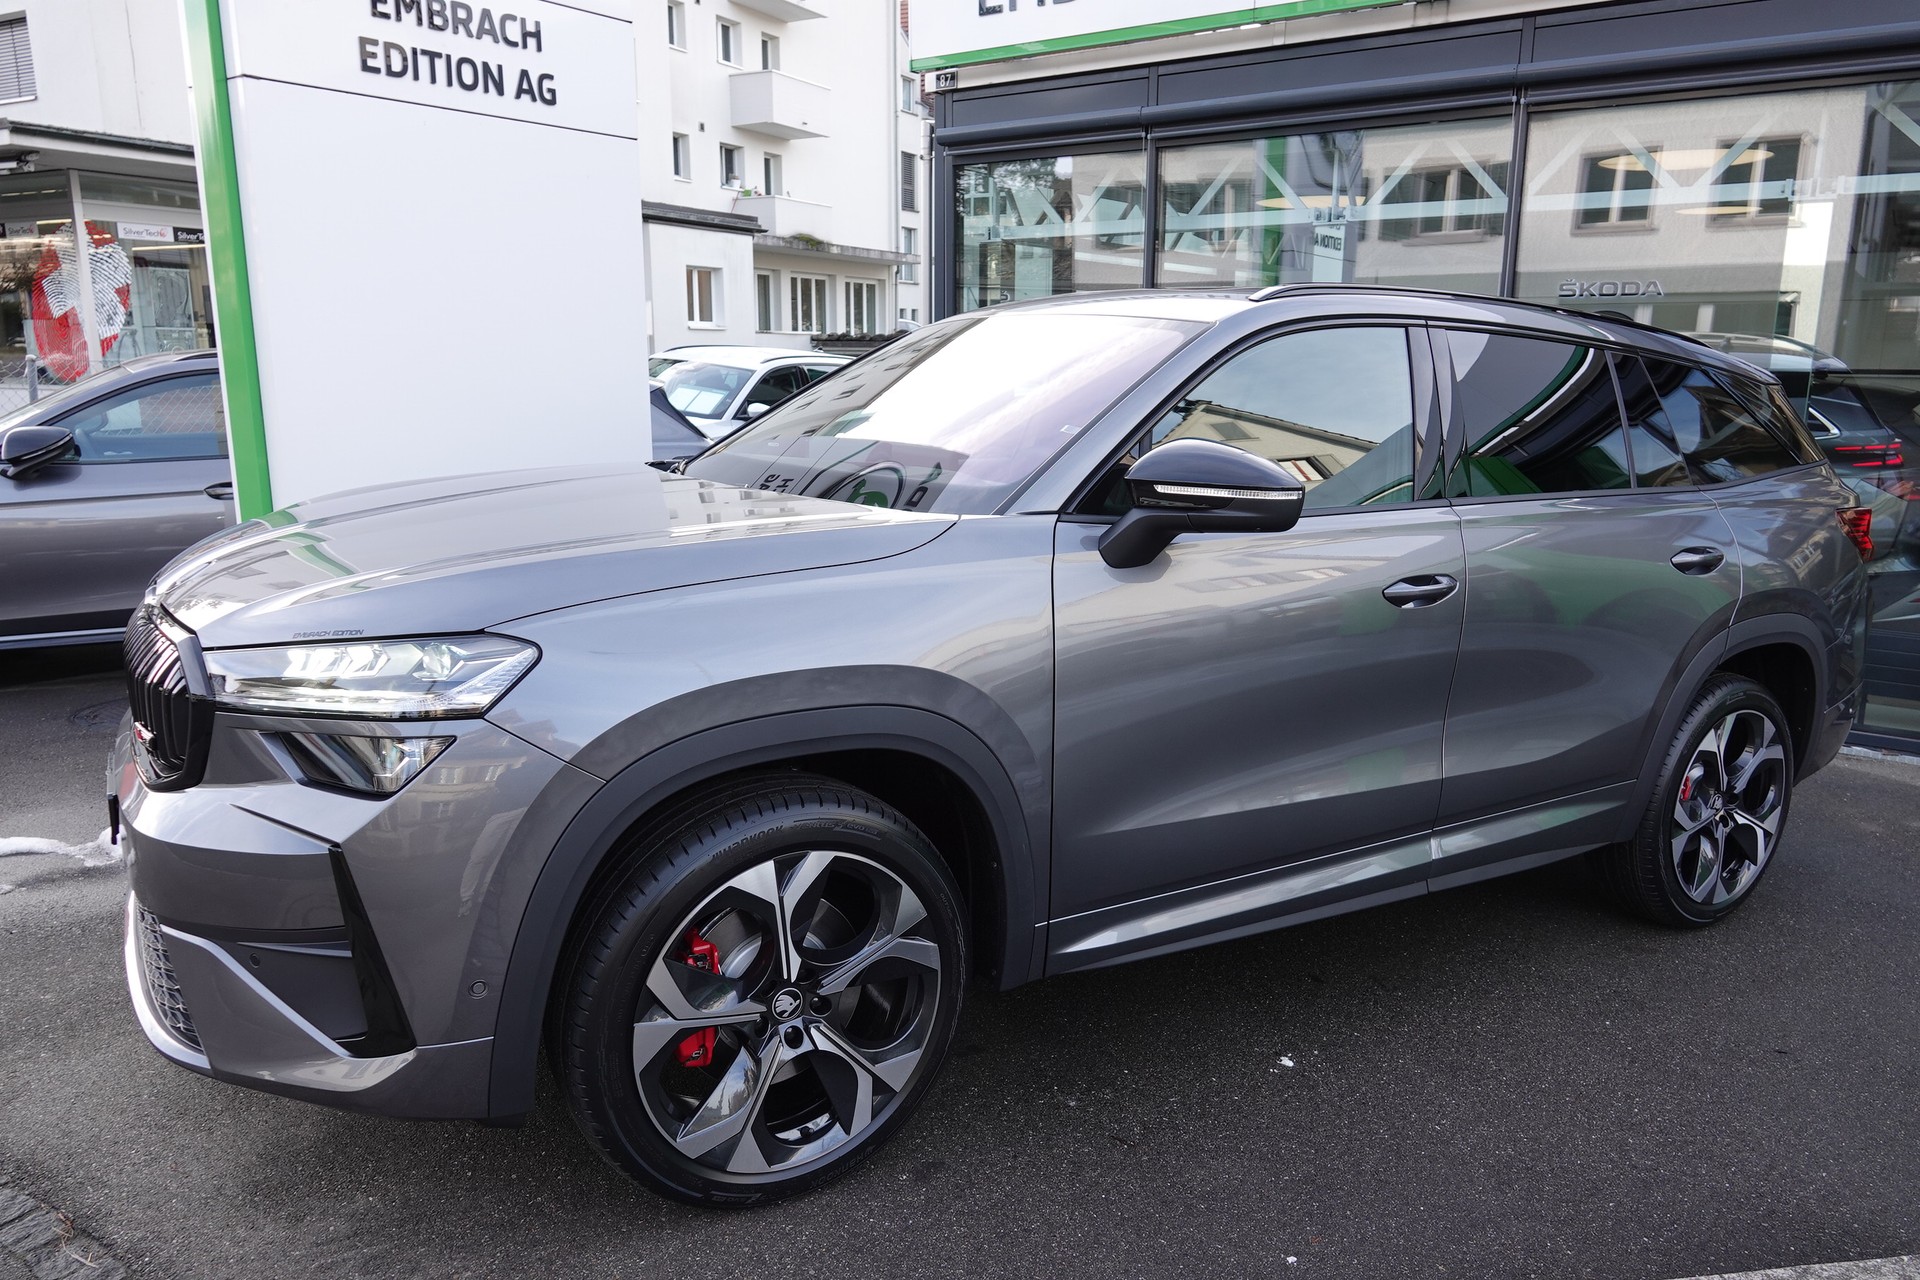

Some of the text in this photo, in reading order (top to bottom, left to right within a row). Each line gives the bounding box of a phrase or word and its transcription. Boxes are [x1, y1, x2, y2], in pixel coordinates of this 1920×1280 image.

[358, 35, 557, 106] EDITION AG
[940, 74, 951, 87] 87
[1558, 279, 1663, 298] ŠKODA
[332, 629, 365, 637] EDITION
